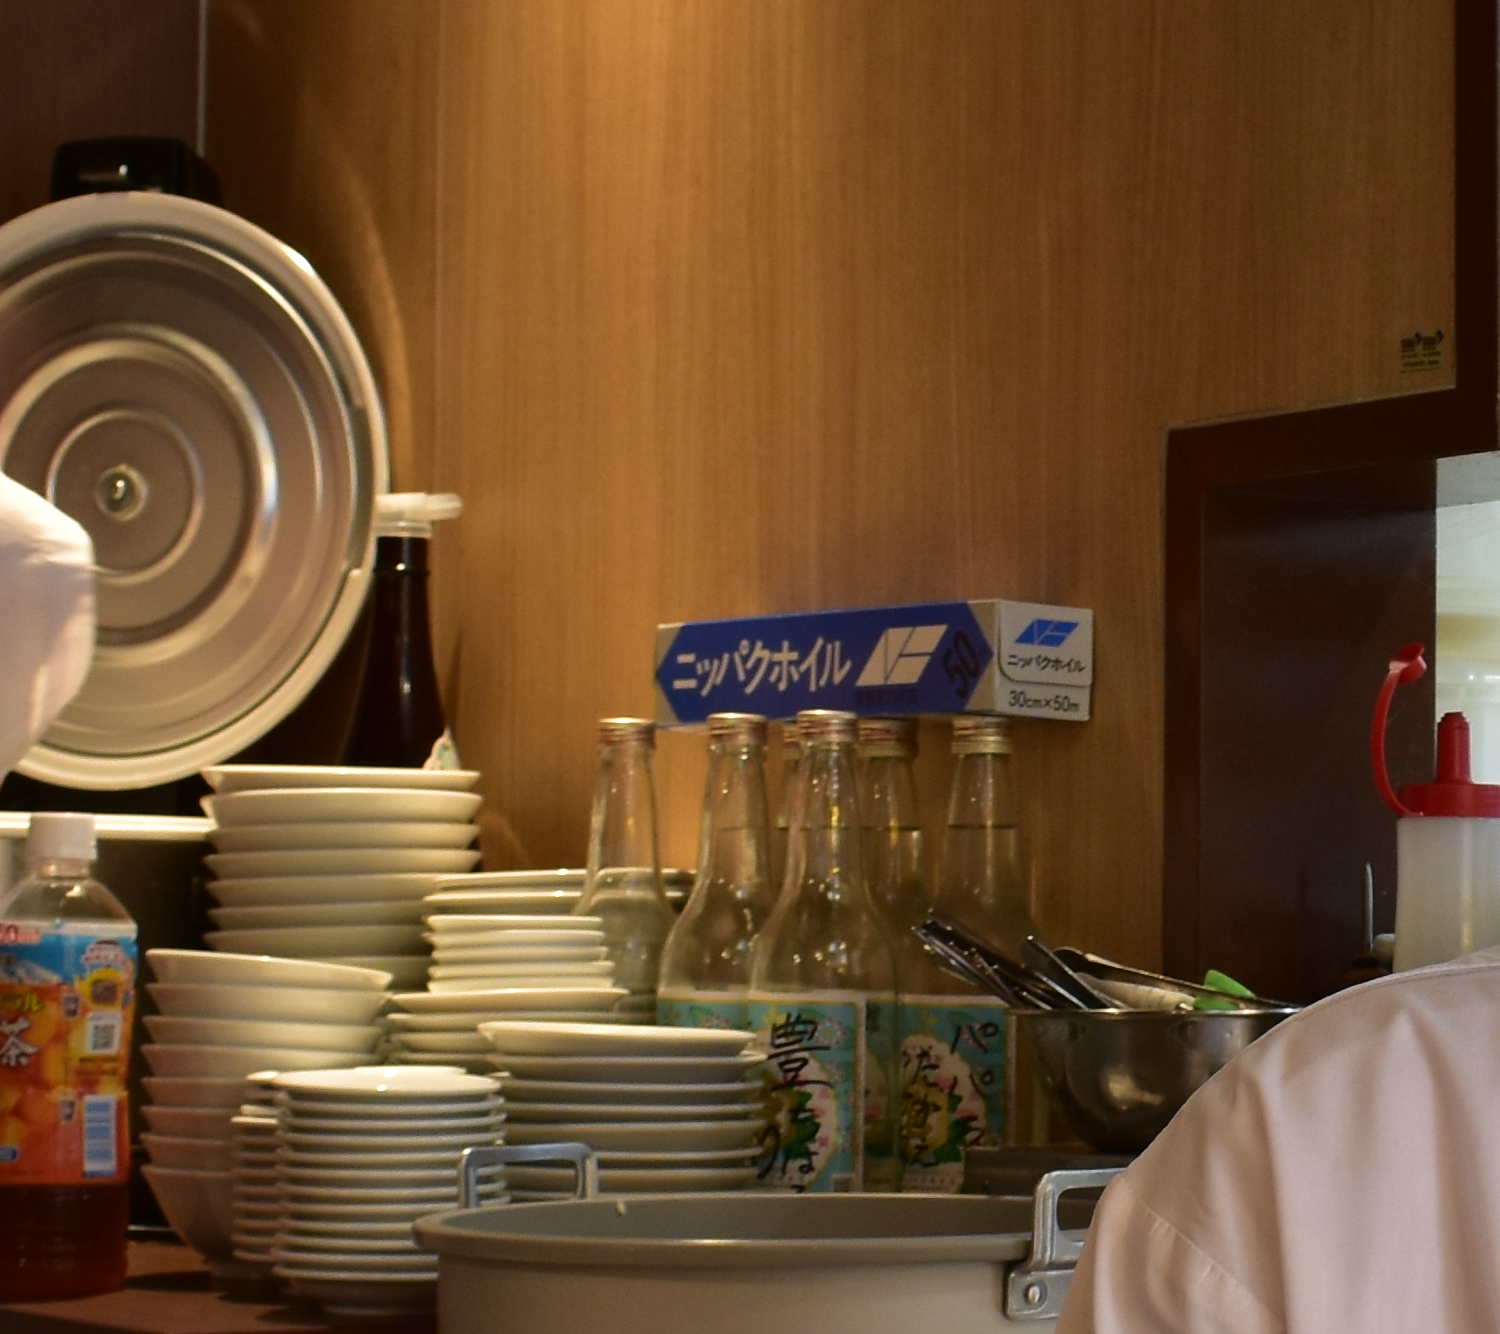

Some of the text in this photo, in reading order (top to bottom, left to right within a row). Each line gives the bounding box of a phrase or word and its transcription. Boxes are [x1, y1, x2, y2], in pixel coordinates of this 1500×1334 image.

[673, 636, 852, 697] ニッパクホイル
